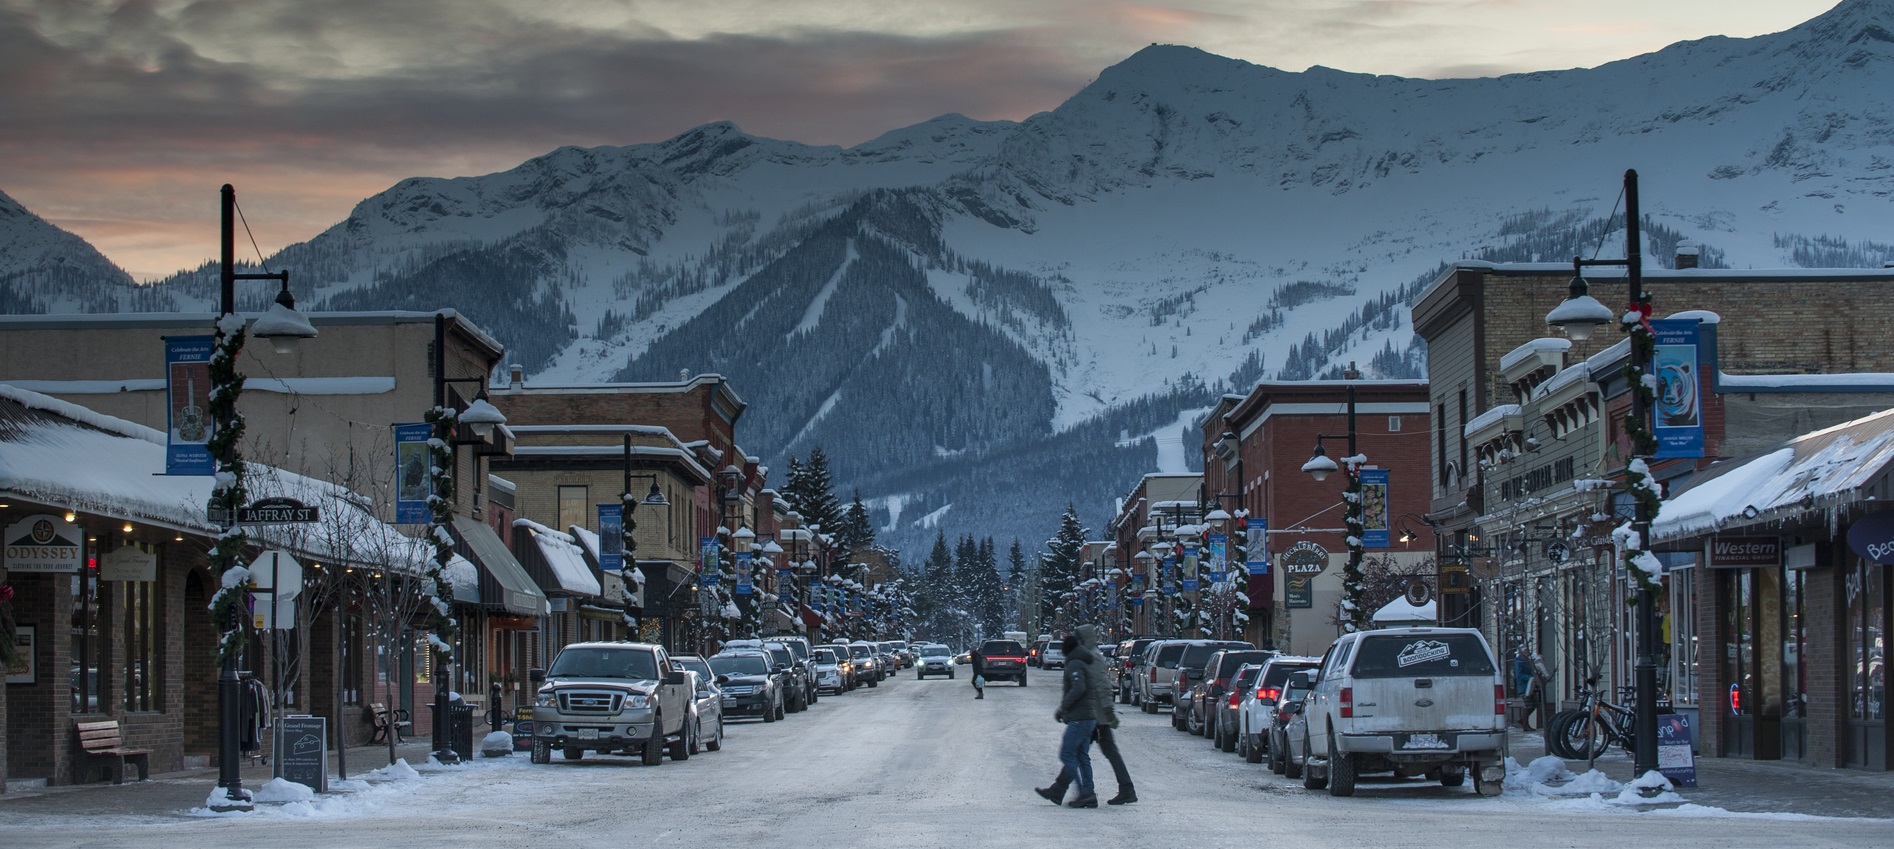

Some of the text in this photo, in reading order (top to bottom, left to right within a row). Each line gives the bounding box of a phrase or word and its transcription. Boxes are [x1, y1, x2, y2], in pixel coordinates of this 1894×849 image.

[246, 510, 311, 521] JAFFRAY ST
[1591, 533, 1614, 546] Guide
[6, 547, 79, 560] ODYSSEY
[1282, 543, 1327, 561] HUCKLEBERRY
[1715, 542, 1776, 555] Western
[1287, 564, 1322, 573] PLAZA
[1403, 647, 1445, 663] BOONDOCKING
